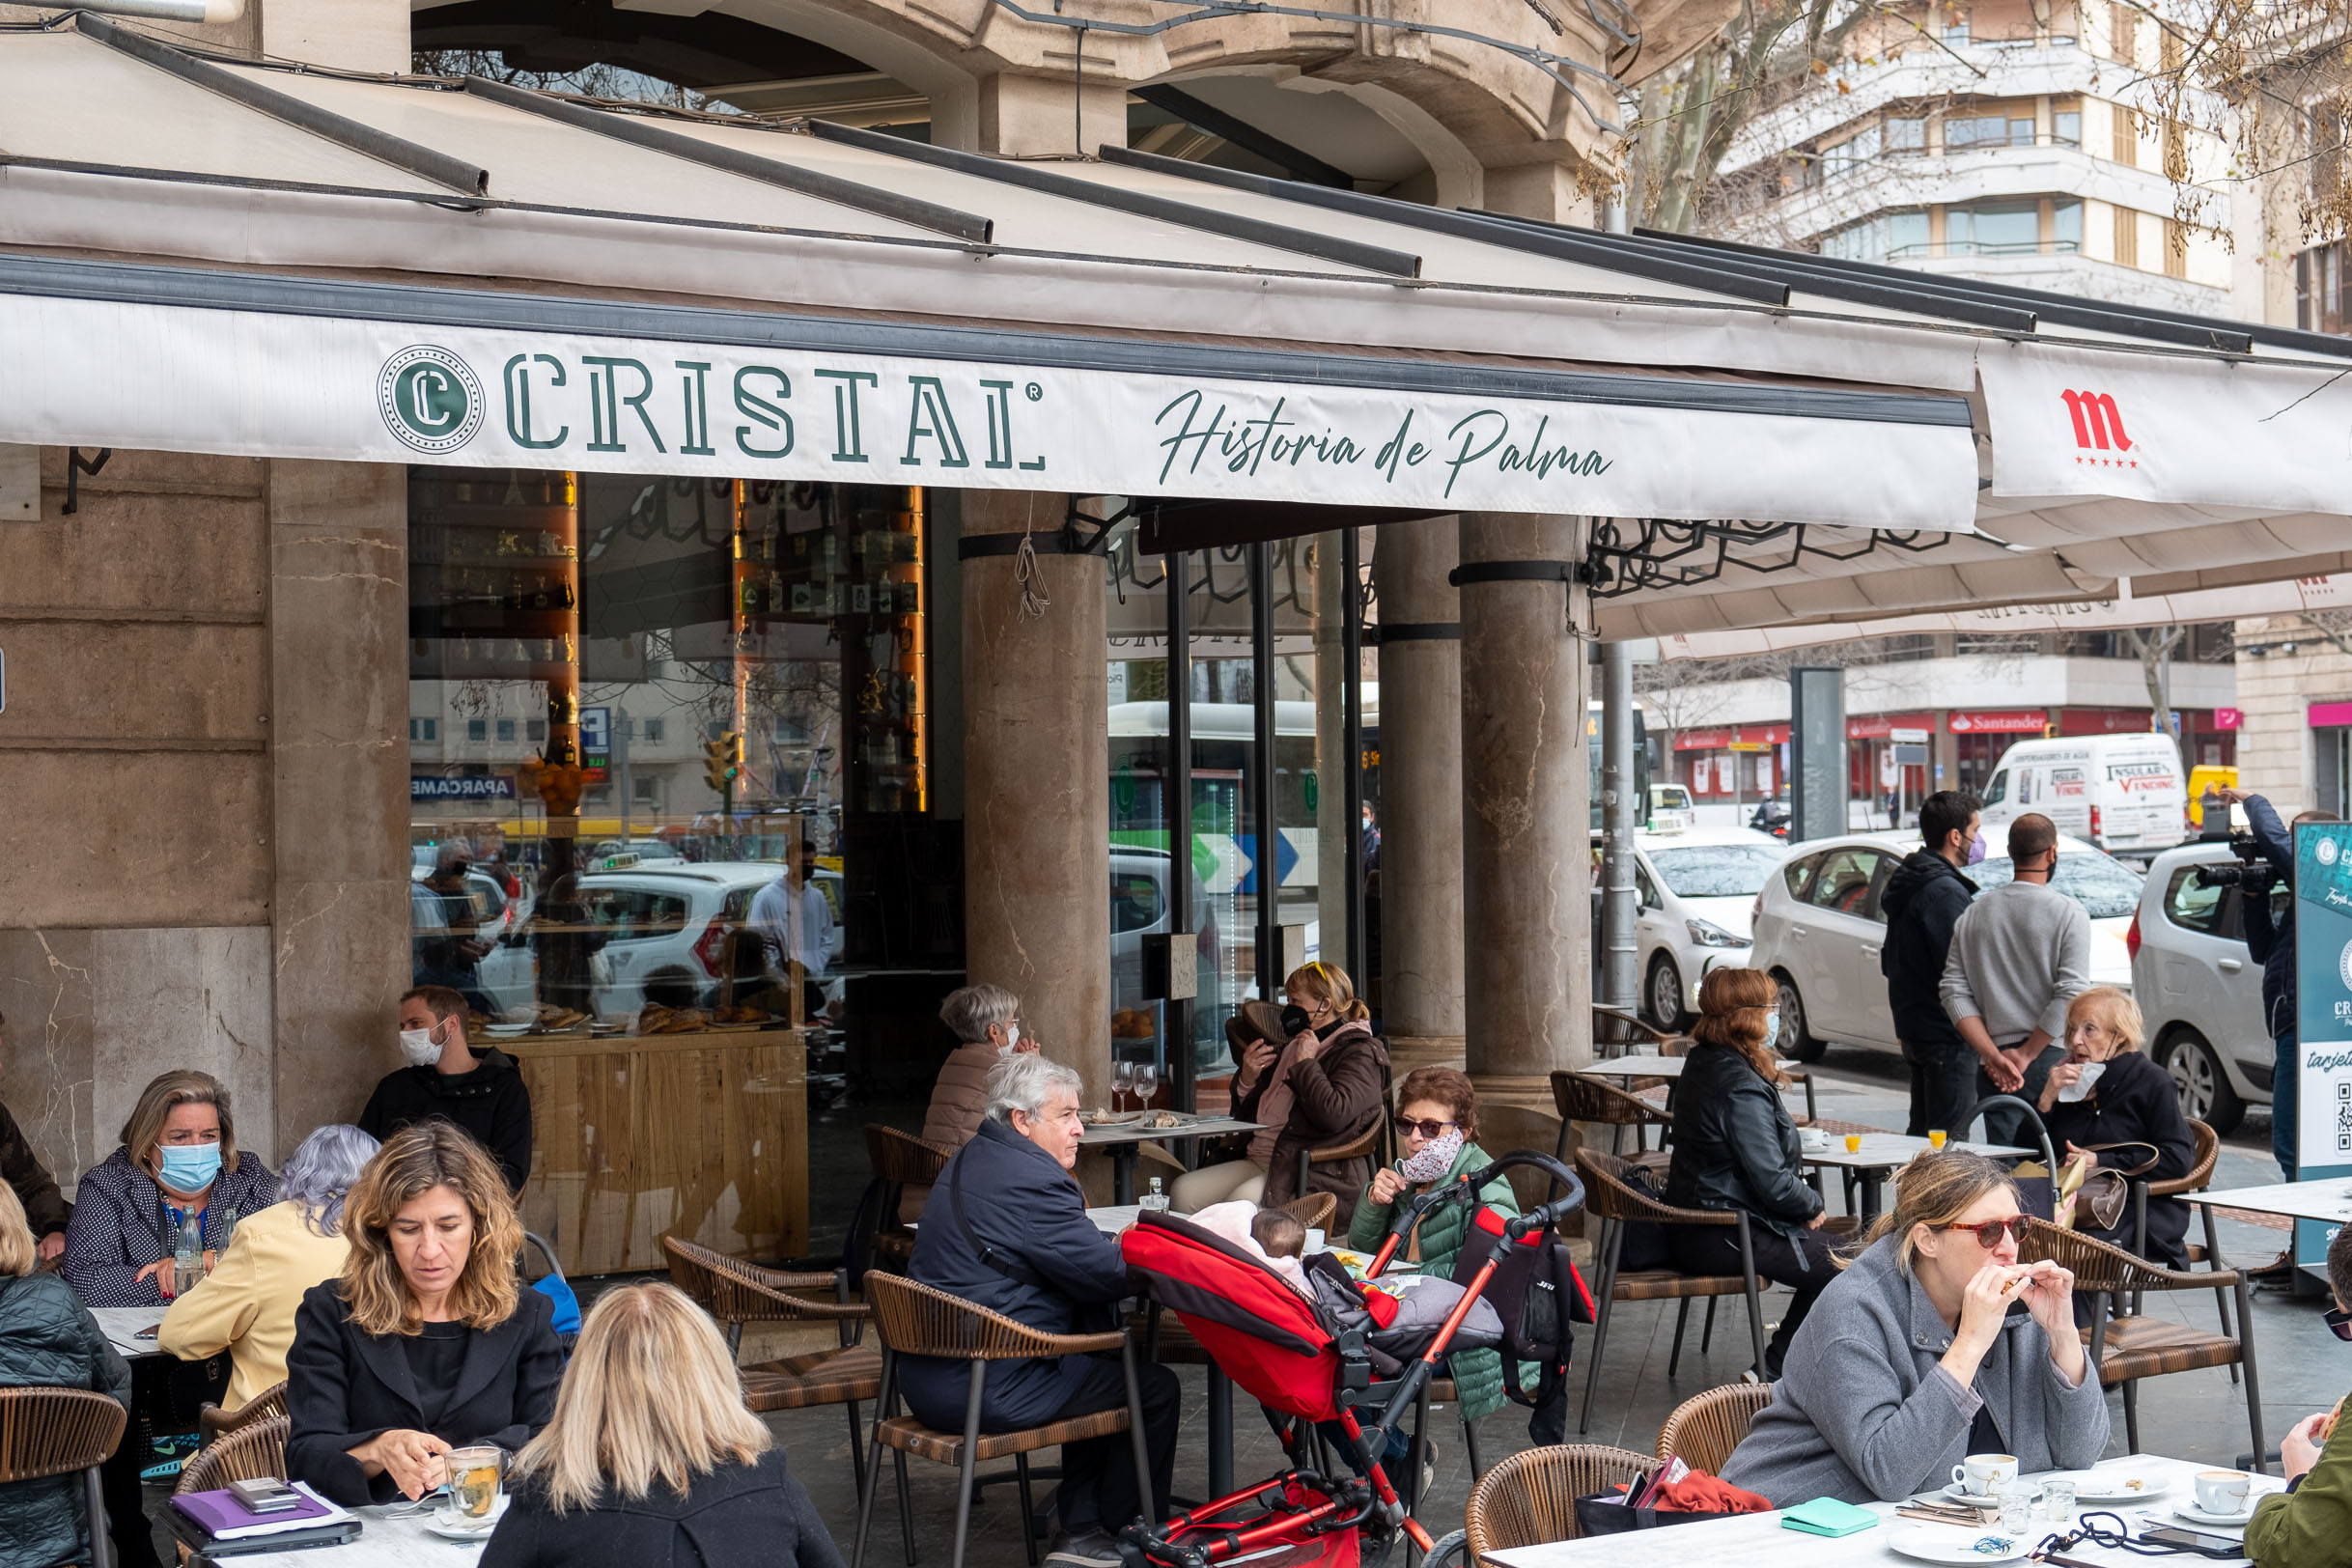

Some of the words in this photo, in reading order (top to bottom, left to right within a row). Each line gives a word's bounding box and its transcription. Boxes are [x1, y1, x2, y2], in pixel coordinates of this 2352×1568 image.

[1155, 389, 1365, 485] Historia
[1375, 408, 1432, 483] de
[1444, 409, 1613, 499] Palma
[1974, 714, 2045, 729] Santander
